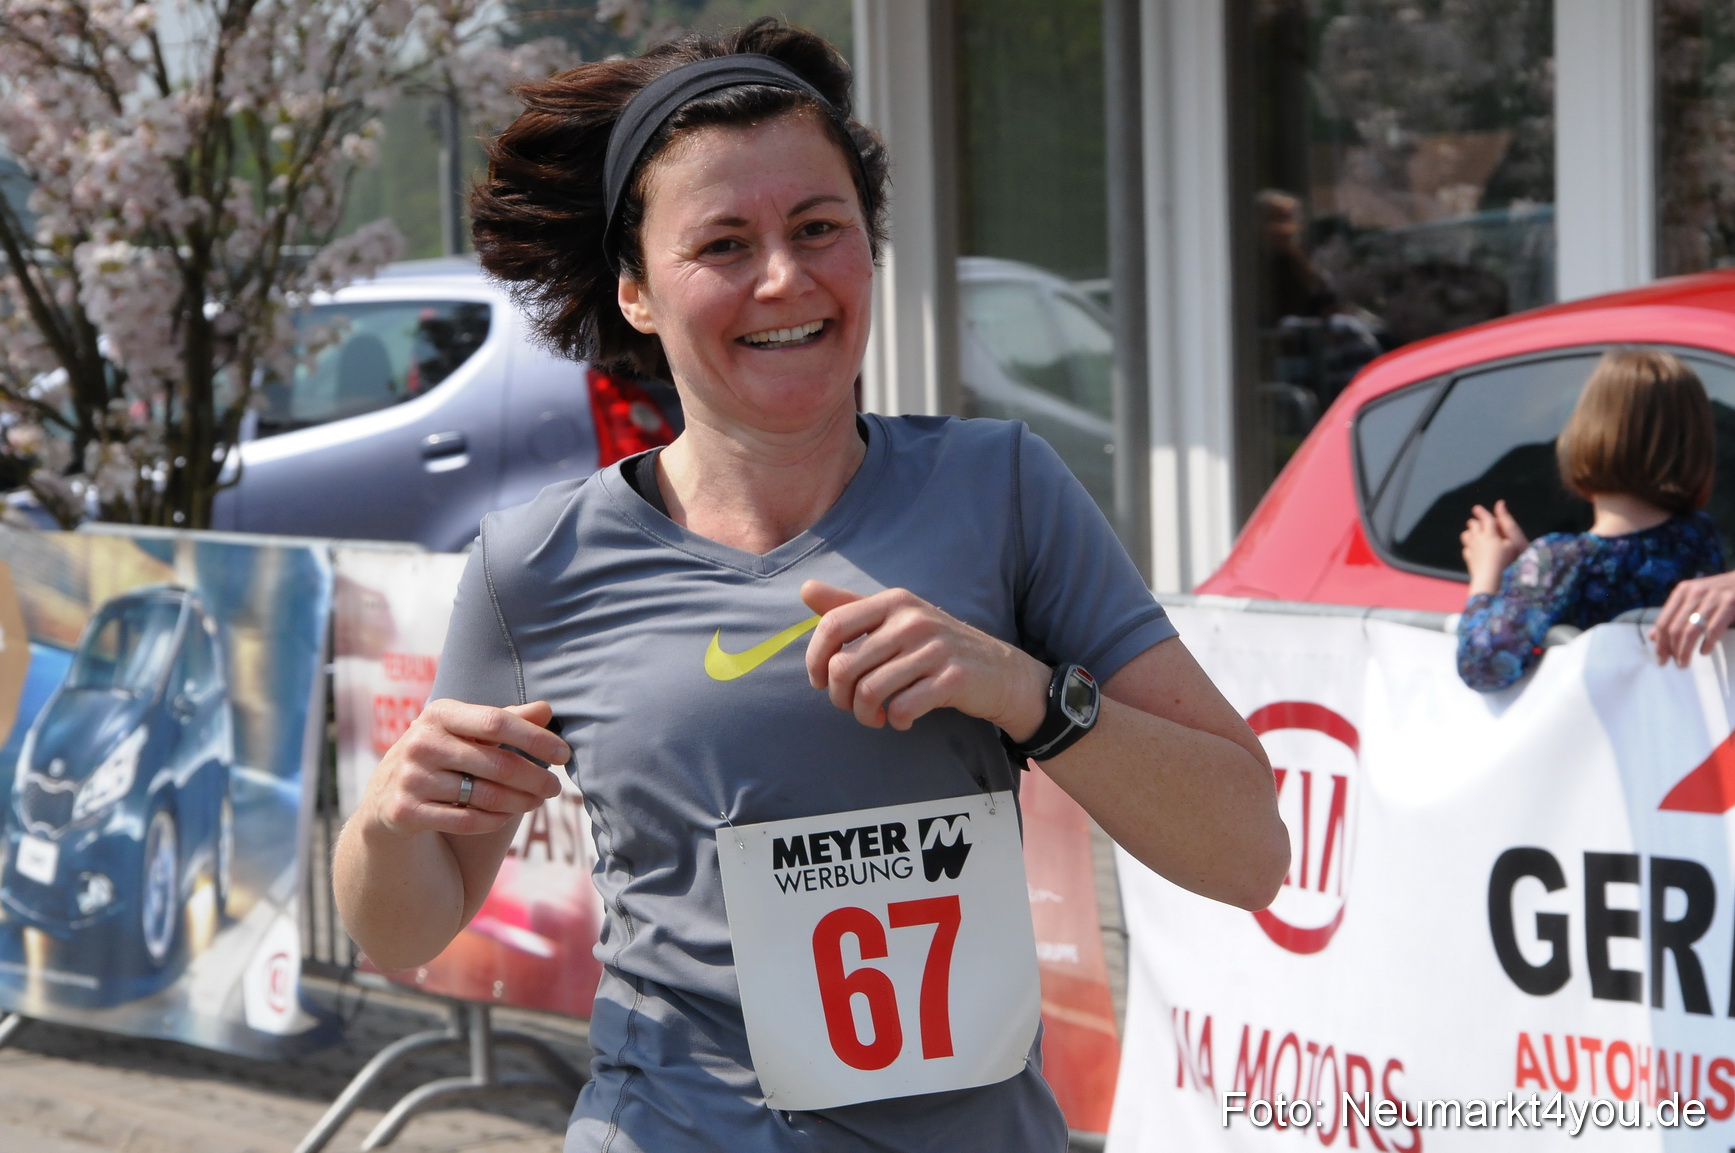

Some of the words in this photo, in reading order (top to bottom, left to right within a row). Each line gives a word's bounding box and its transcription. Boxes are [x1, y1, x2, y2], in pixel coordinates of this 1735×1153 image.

[773, 822, 910, 870] MEYER
[774, 856, 914, 895] WERBUNG
[812, 894, 962, 1071] 67
[1488, 846, 1735, 1019] GER
[1231, 1023, 1423, 1153] MOTORS
[1515, 1031, 1735, 1121] AUTOHAUS
